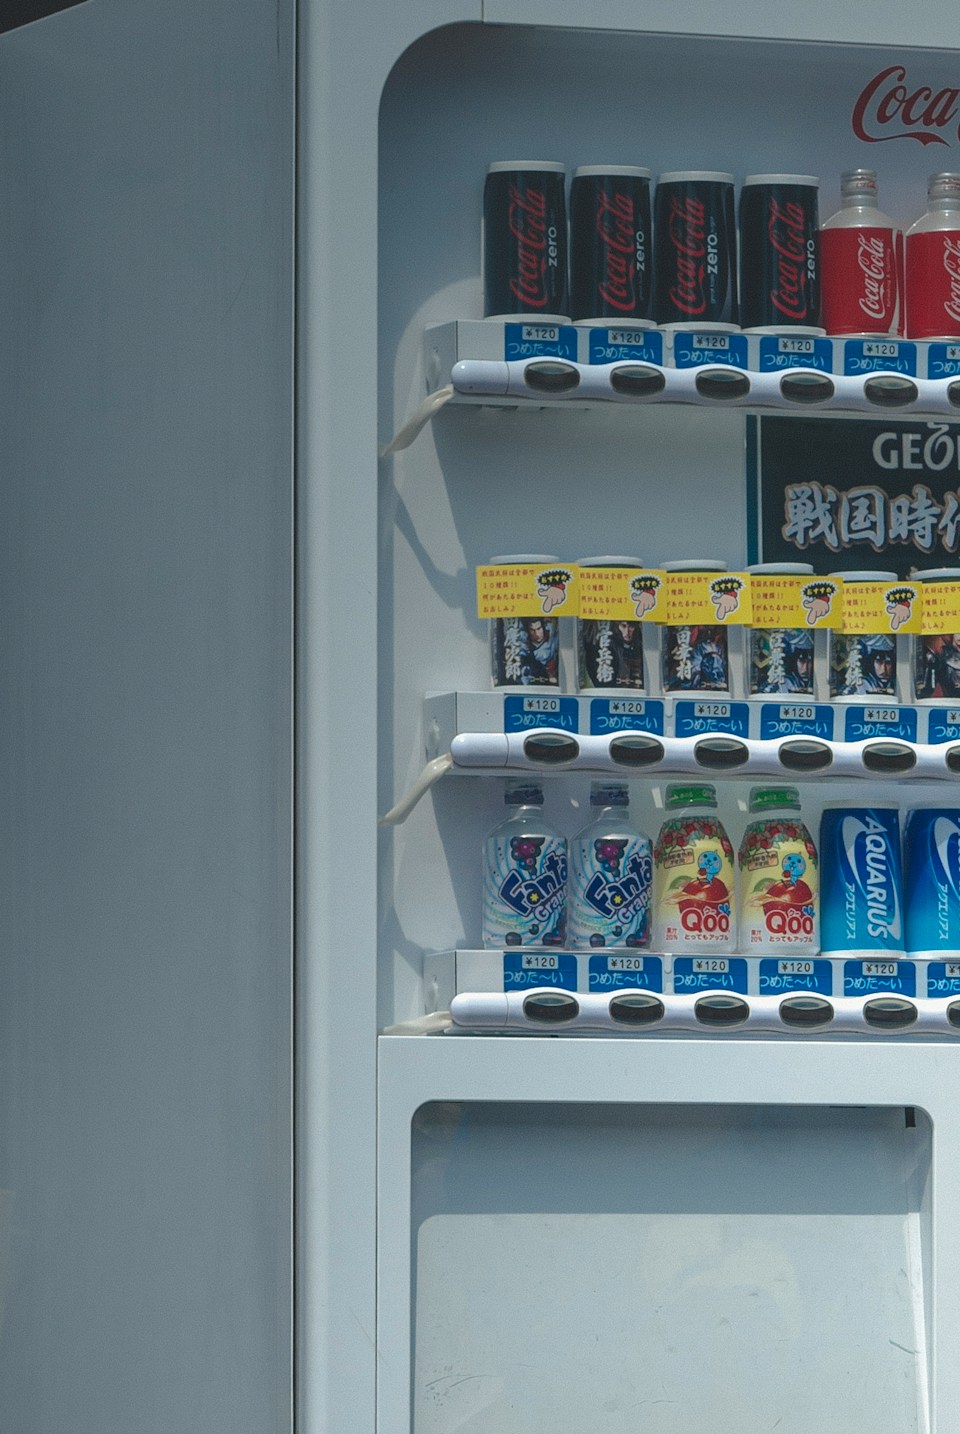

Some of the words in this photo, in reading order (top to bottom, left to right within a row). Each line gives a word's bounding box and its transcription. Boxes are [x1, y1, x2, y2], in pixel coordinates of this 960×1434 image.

[548, 226, 557, 267] zero
[636, 231, 645, 272] zero
[707, 233, 718, 275] zero
[806, 239, 815, 280] zero
[858, 232, 886, 319] Coca-Cola
[526, 329, 555, 338] ¥120
[612, 334, 640, 343] ¥120
[697, 338, 726, 347] ¥120
[783, 341, 810, 350] ¥120
[867, 345, 895, 354] ¥120
[527, 700, 557, 709] ¥120
[613, 703, 641, 712] ¥120
[698, 706, 727, 715] ¥120
[784, 708, 812, 717] ¥120
[868, 711, 896, 720] ¥120
[865, 816, 888, 939] AQUARIUS
[499, 851, 568, 918] Fanta
[583, 852, 653, 919] Fanta
[845, 881, 856, 940] アクエリアス
[937, 882, 949, 940] アクエリアス
[681, 908, 730, 933] Qoo
[765, 911, 815, 936] Qoo
[526, 957, 555, 967] ¥120
[611, 960, 640, 969] ¥120
[697, 961, 725, 970] ¥120
[782, 963, 810, 972] ¥120
[866, 964, 894, 974] ¥120
